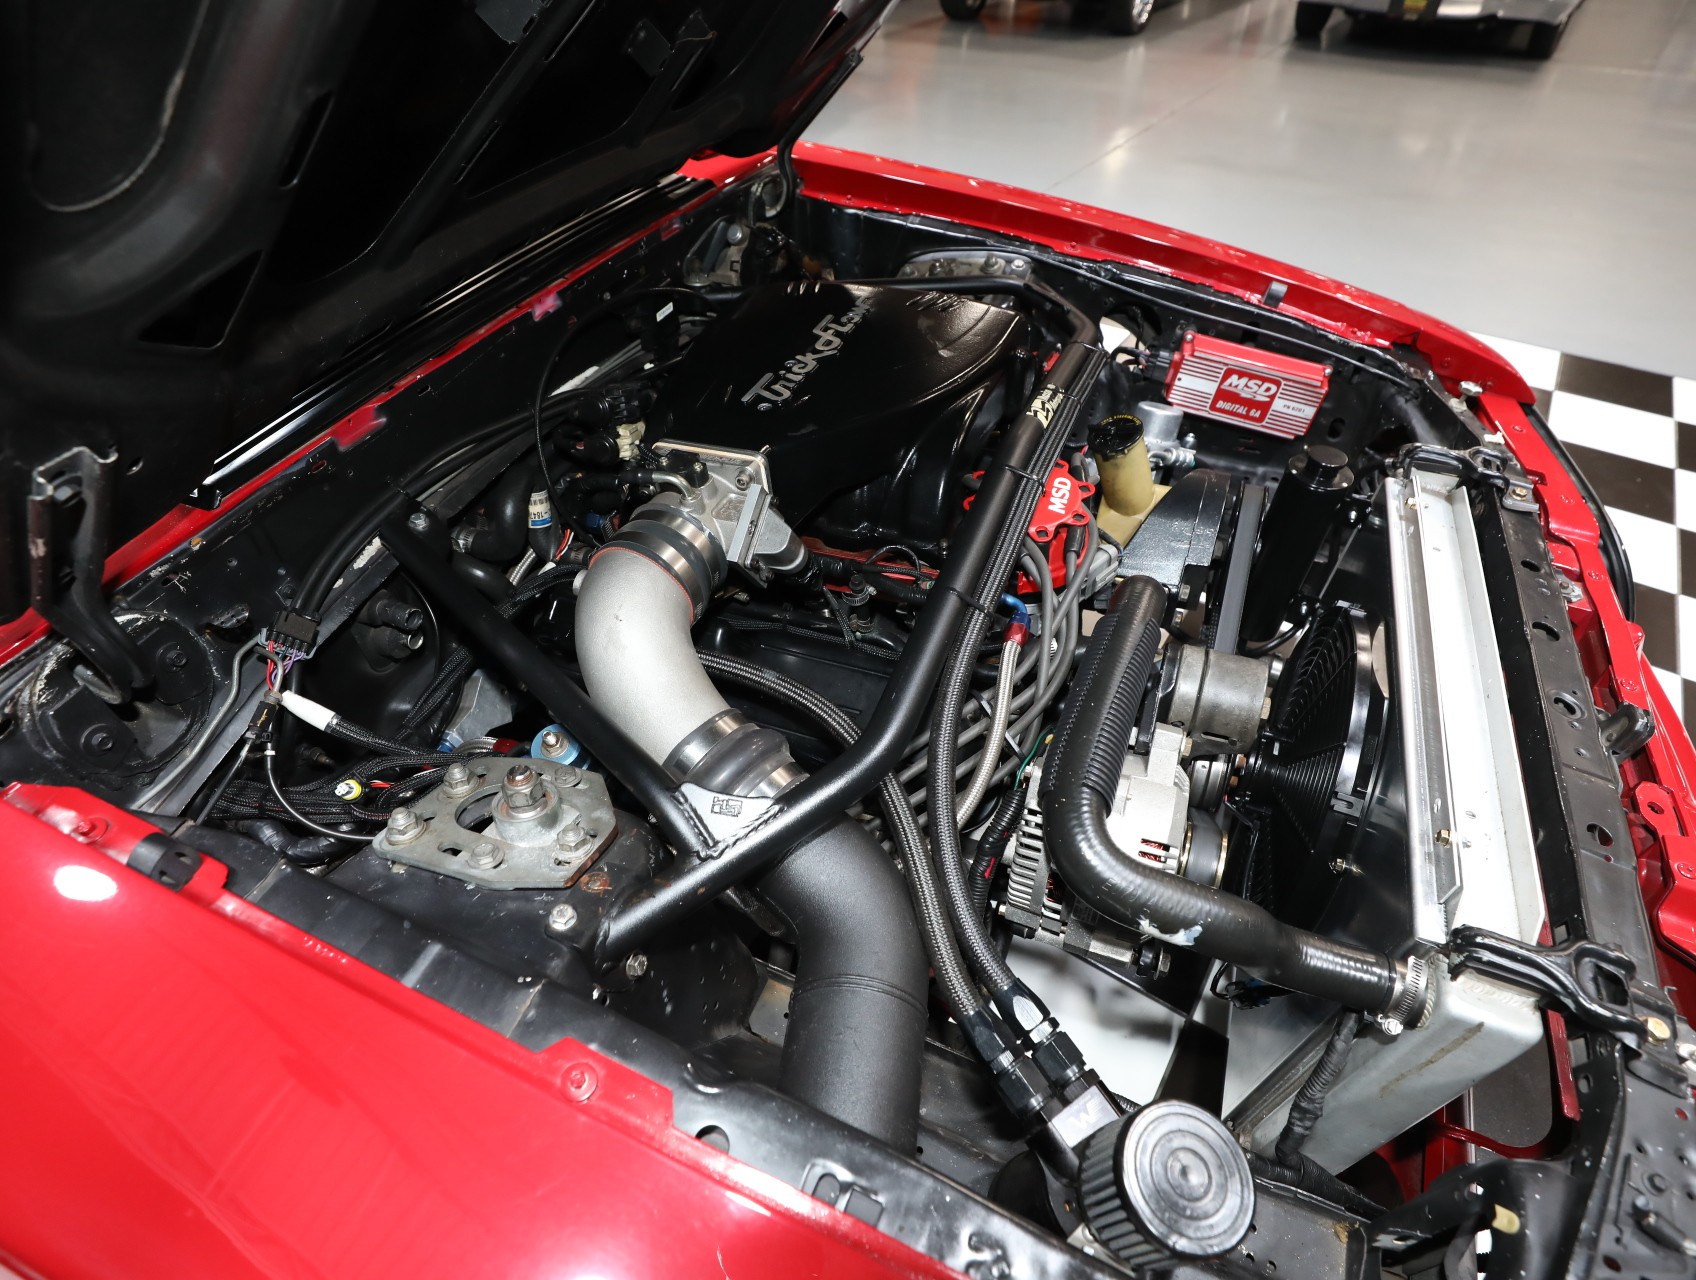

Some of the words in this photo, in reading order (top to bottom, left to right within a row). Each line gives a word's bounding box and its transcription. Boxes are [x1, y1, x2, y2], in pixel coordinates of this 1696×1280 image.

[1222, 374, 1278, 396] MSD
[1216, 401, 1248, 415] DIGITAL
[1249, 409, 1262, 418] 6A
[1048, 477, 1071, 514] MSD
